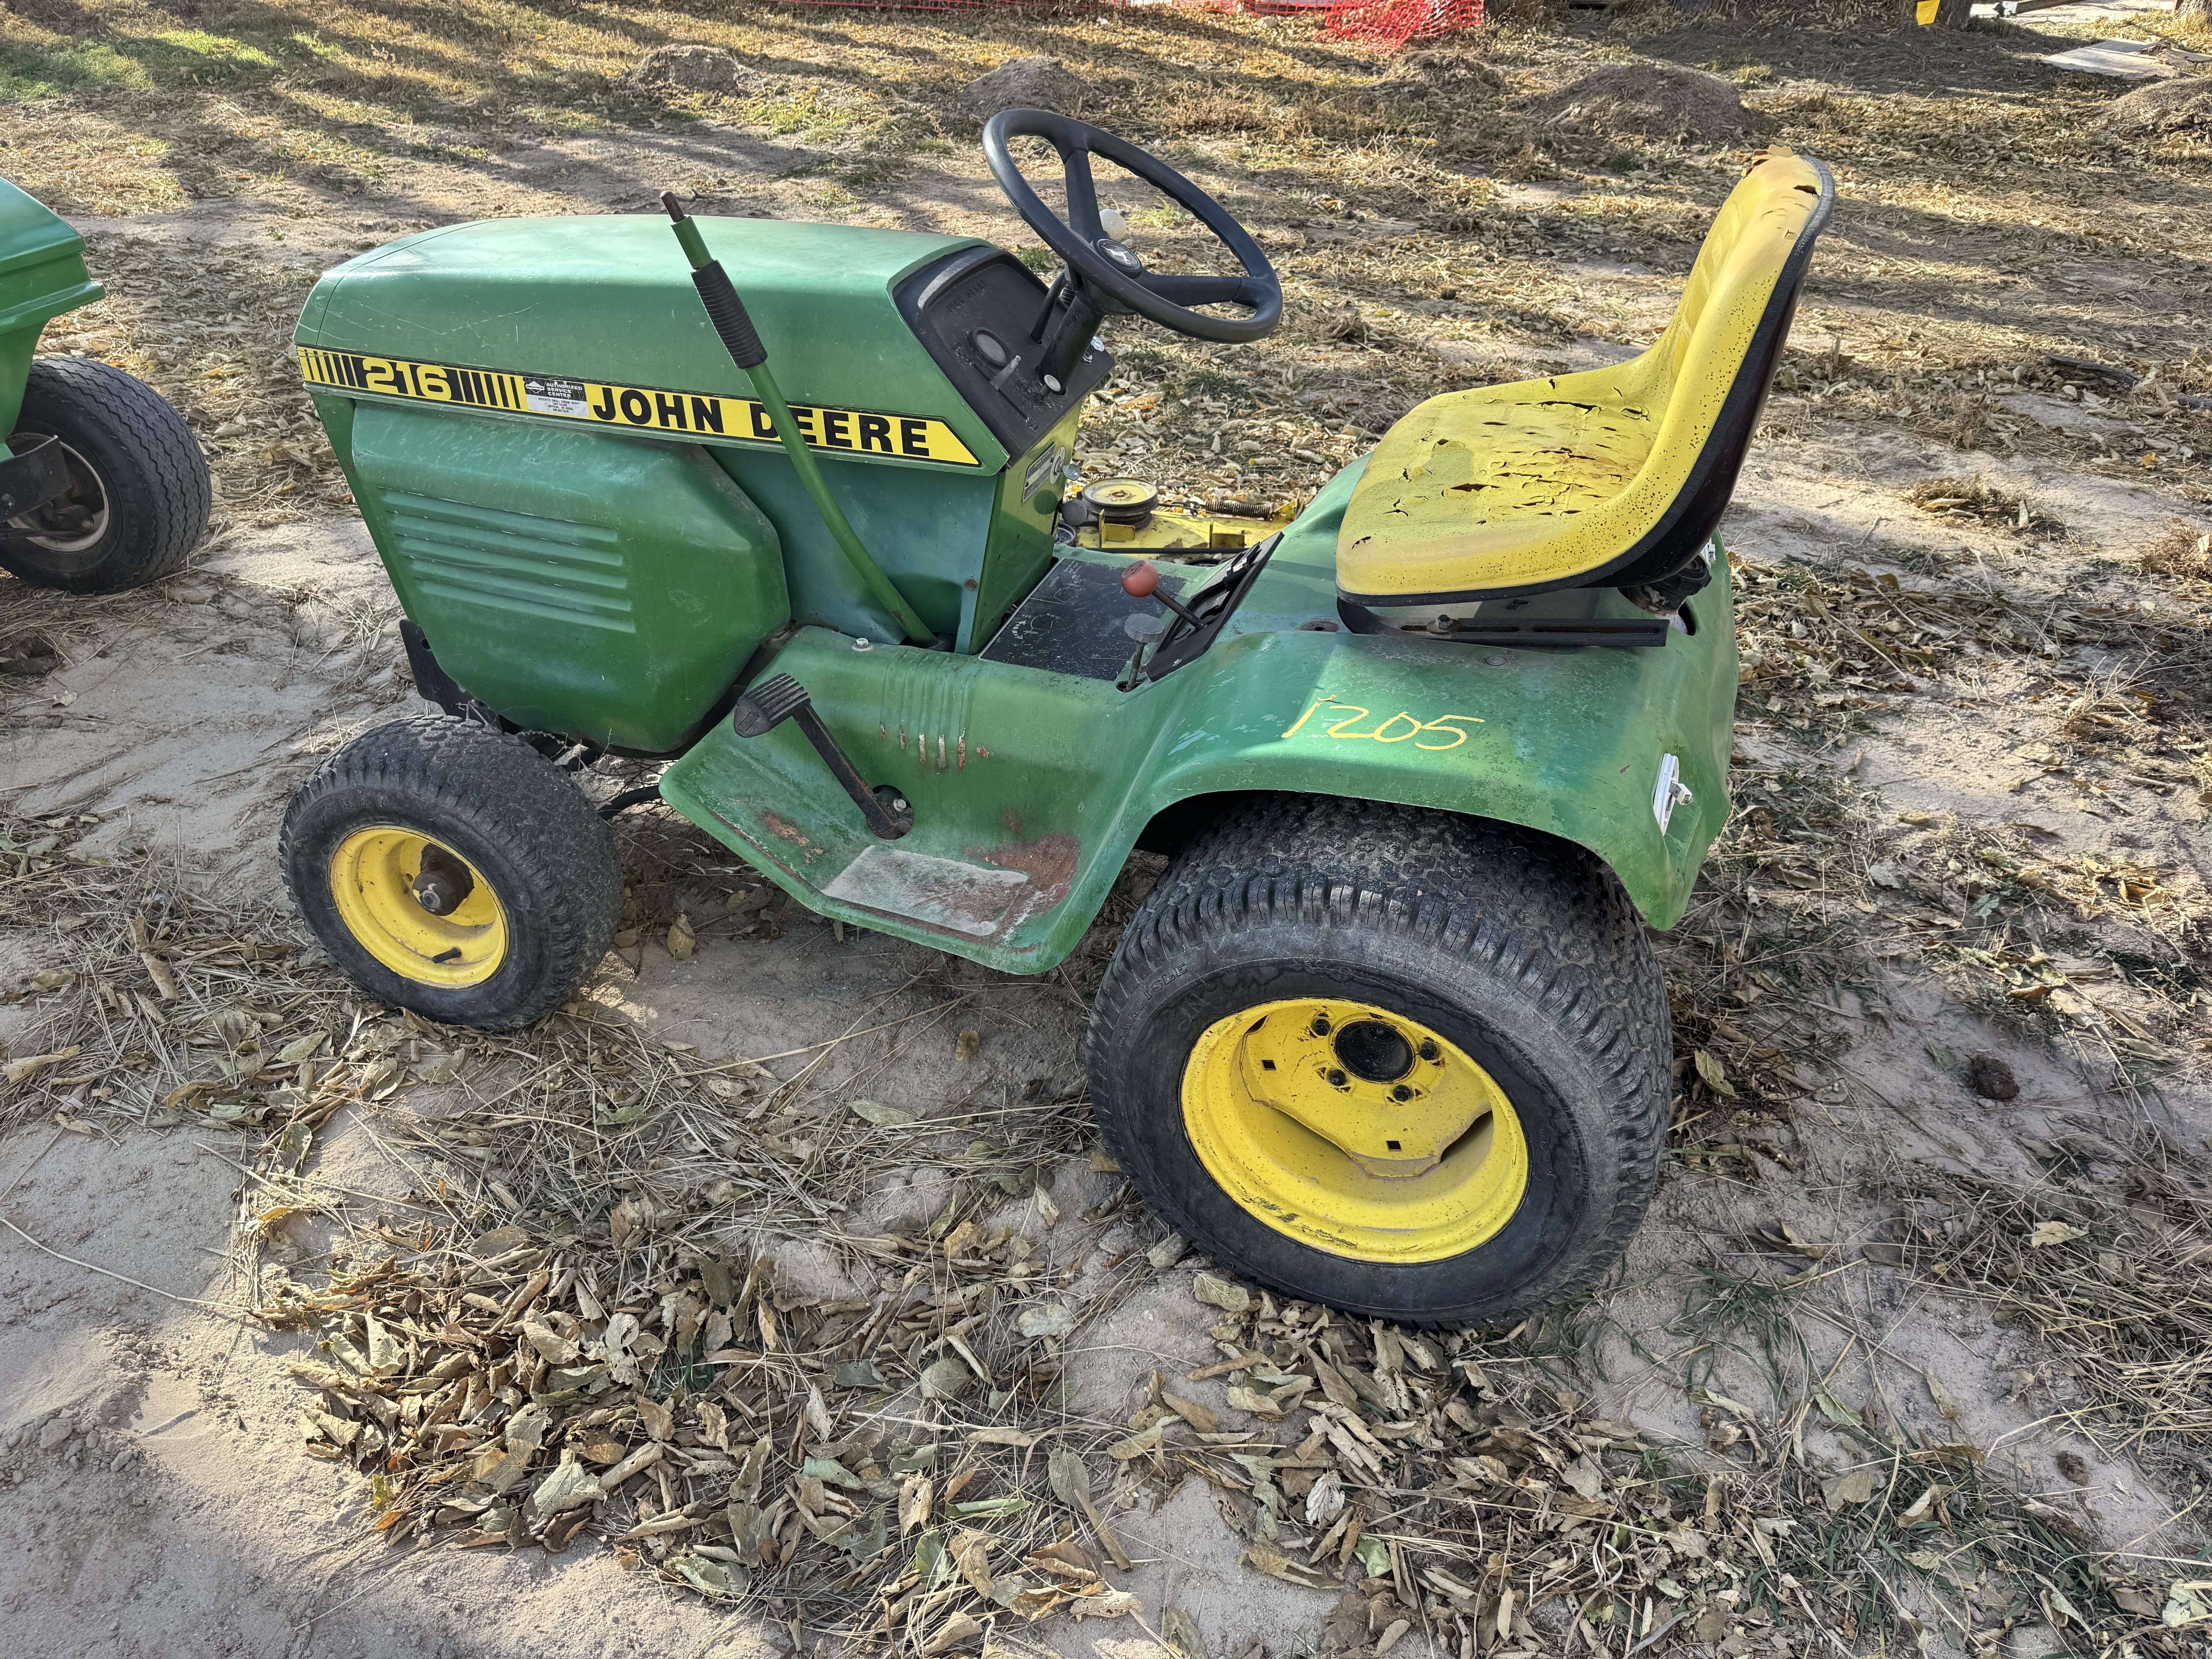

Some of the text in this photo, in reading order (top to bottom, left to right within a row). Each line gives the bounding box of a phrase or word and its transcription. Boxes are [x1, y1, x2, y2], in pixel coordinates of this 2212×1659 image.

[362, 358, 452, 400] 216
[546, 381, 582, 390] AUTHORIZED
[592, 387, 930, 457] JOHN DEERE
[1281, 701, 1486, 750] 1205
[1118, 962, 1189, 1048] CARLISLE
